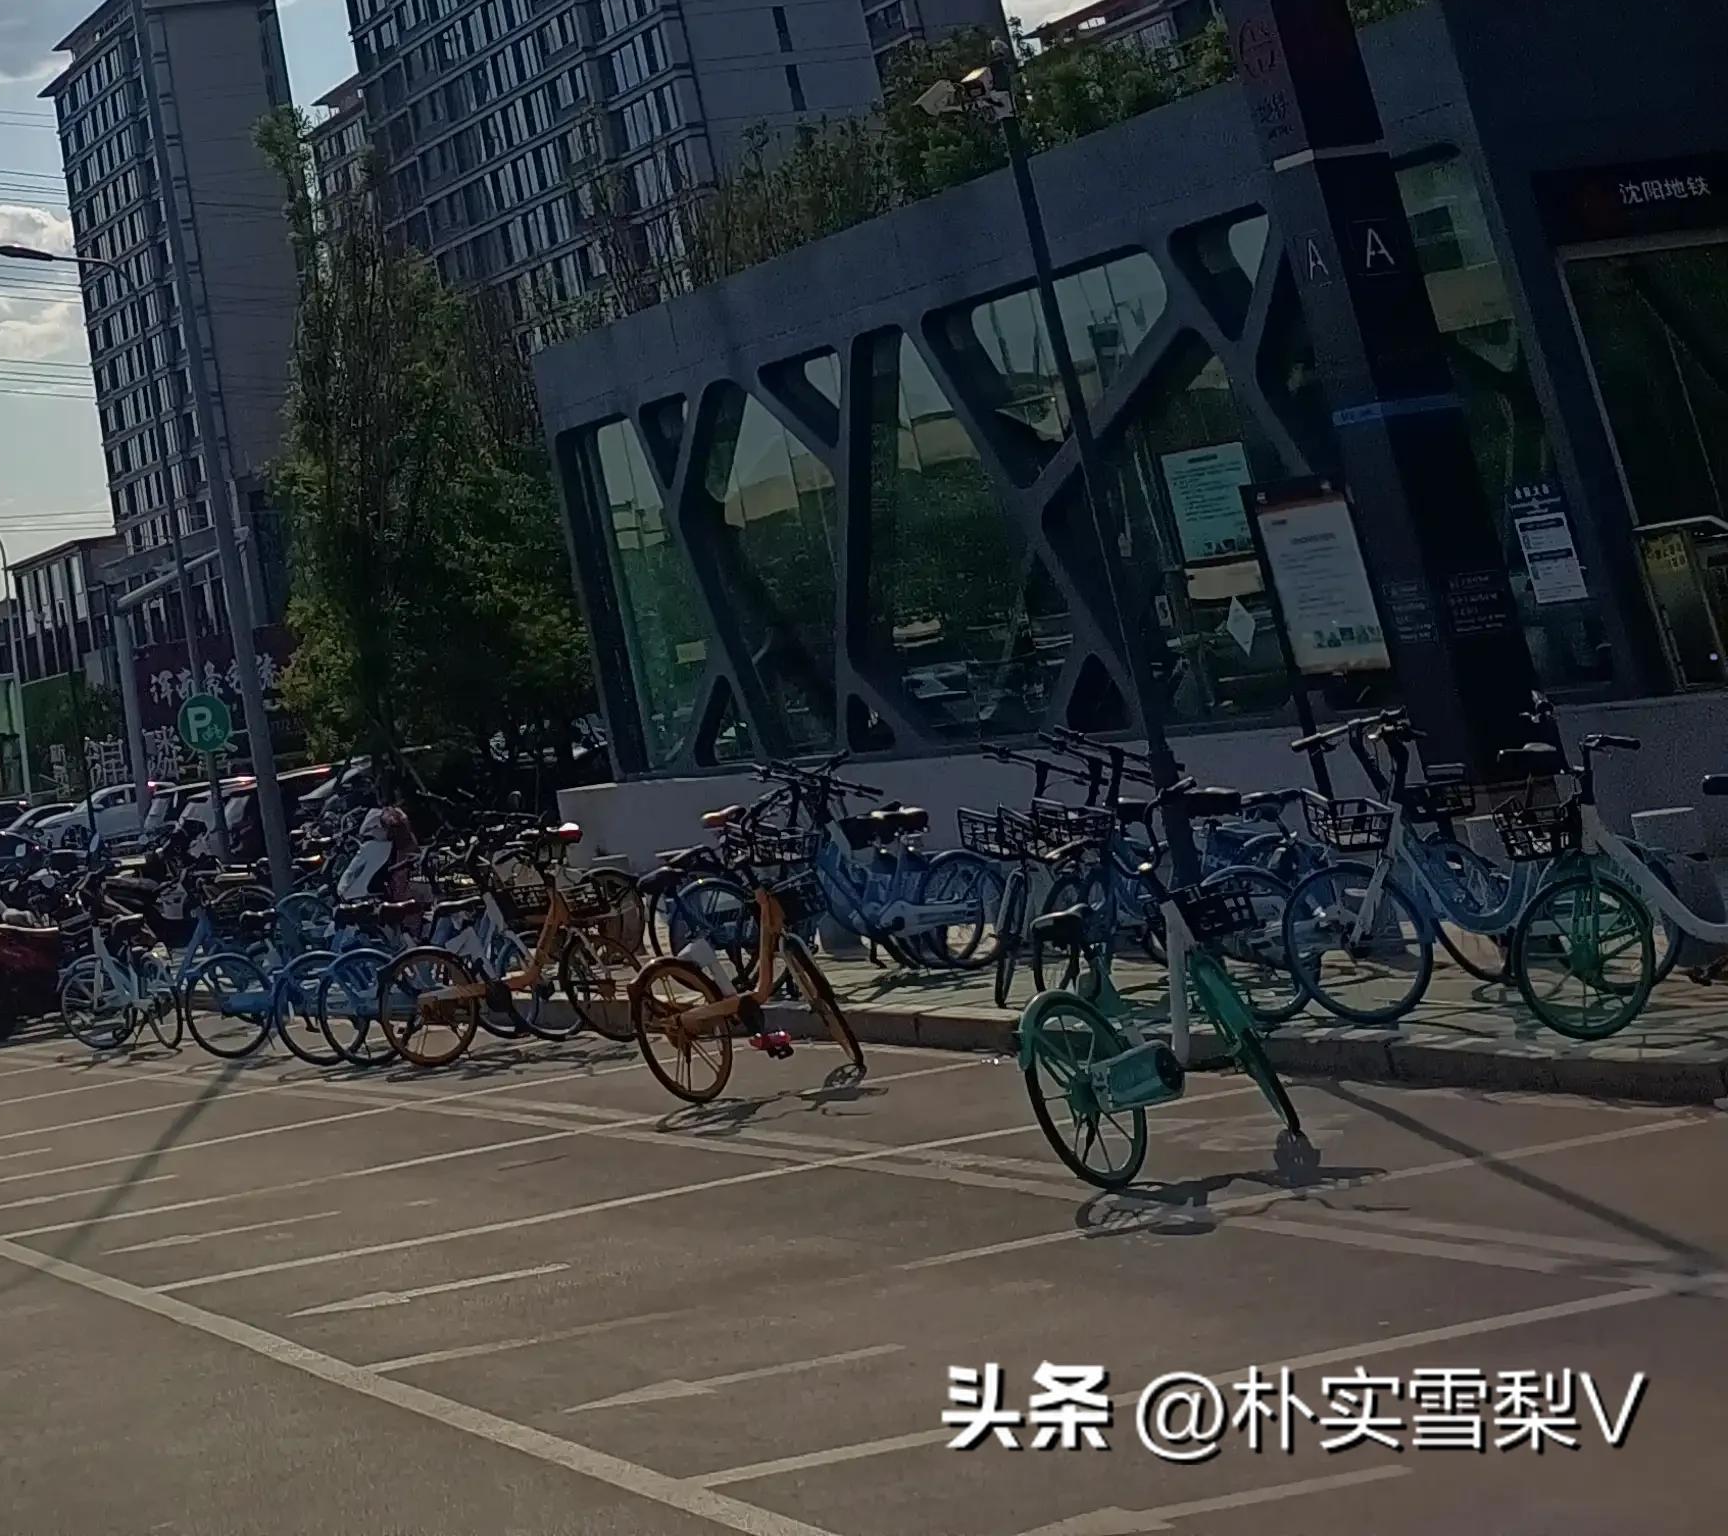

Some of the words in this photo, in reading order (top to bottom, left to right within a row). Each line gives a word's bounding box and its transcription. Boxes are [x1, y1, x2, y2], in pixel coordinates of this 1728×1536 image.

[1618, 175, 1711, 204] 沈阳地铁
[1307, 238, 1329, 280] A
[1366, 227, 1395, 268] A
[186, 706, 213, 743] P
